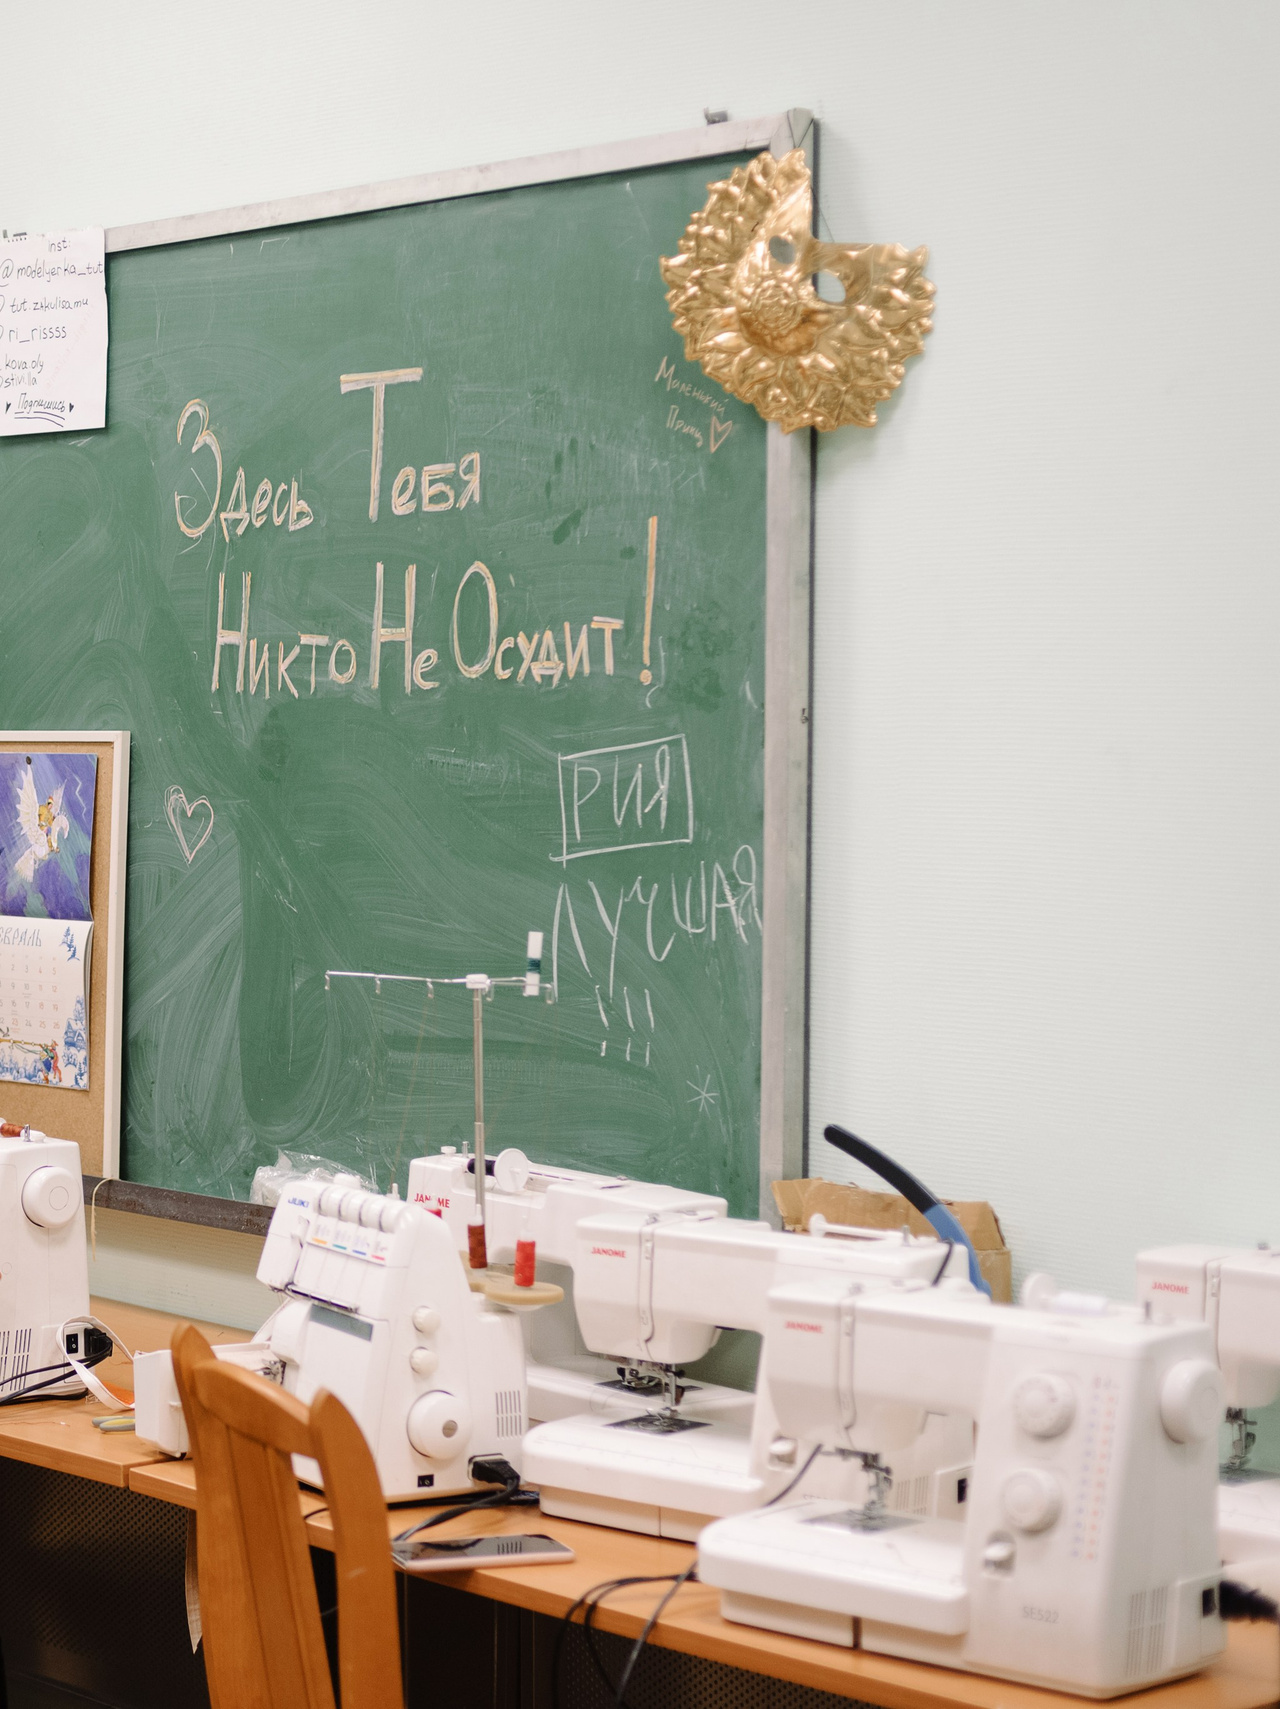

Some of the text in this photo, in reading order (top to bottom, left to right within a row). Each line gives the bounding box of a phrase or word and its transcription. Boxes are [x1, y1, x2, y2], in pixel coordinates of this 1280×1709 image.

[370, 562, 439, 694] Не
[573, 743, 670, 843] РИЯ
[288, 1198, 310, 1208] JUKI
[414, 1192, 451, 1208] JANME
[591, 1246, 627, 1258] JANOME
[1151, 1281, 1190, 1294] JANOME
[785, 1321, 824, 1333] JANOME
[1022, 1605, 1060, 1624] SE522
